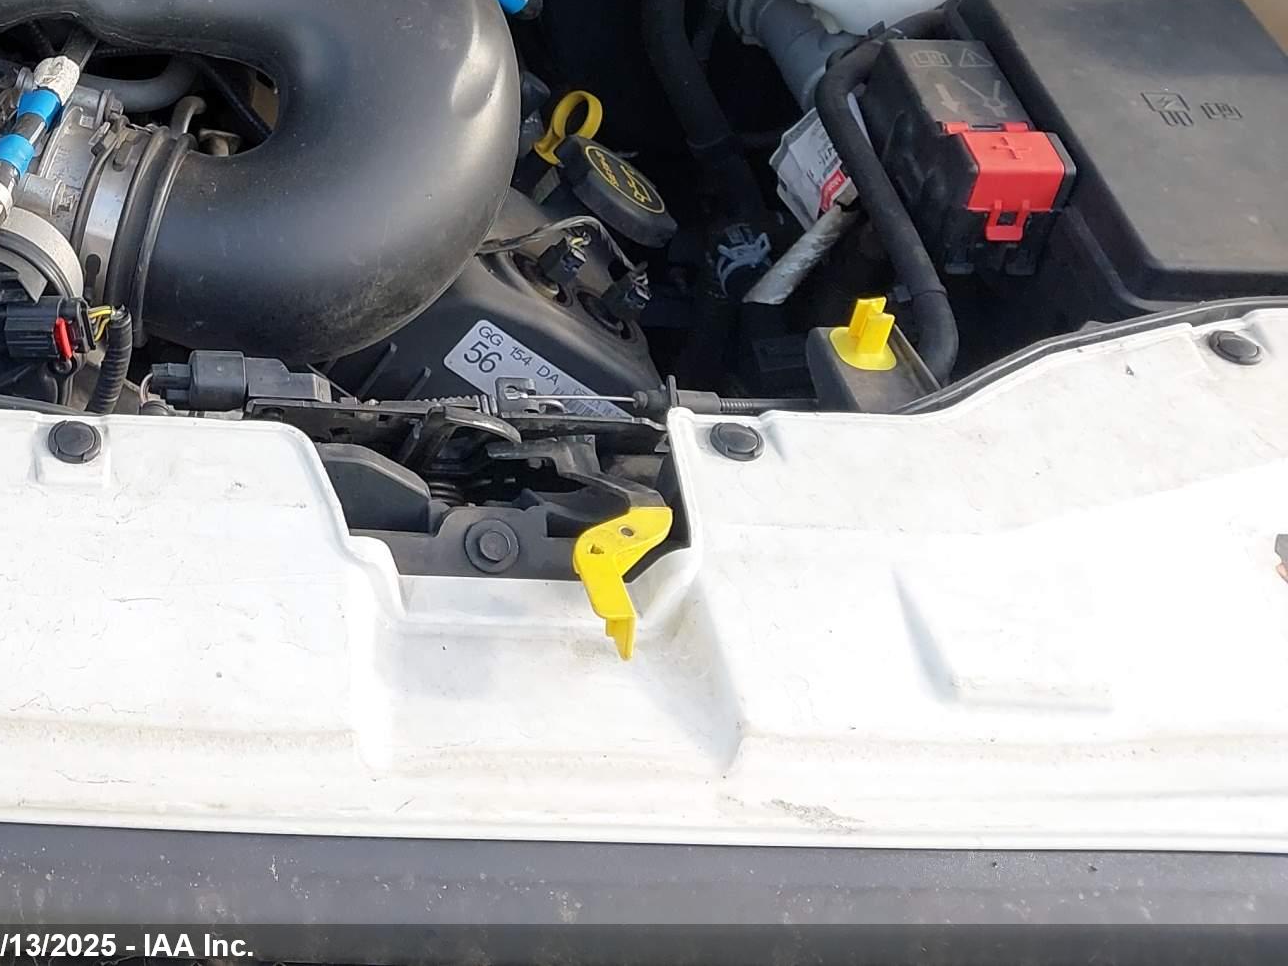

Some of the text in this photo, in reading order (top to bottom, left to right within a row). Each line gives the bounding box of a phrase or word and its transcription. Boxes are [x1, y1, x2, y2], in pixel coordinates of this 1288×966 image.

[464, 340, 502, 373] 56
[479, 326, 559, 385] GG 154 DA
